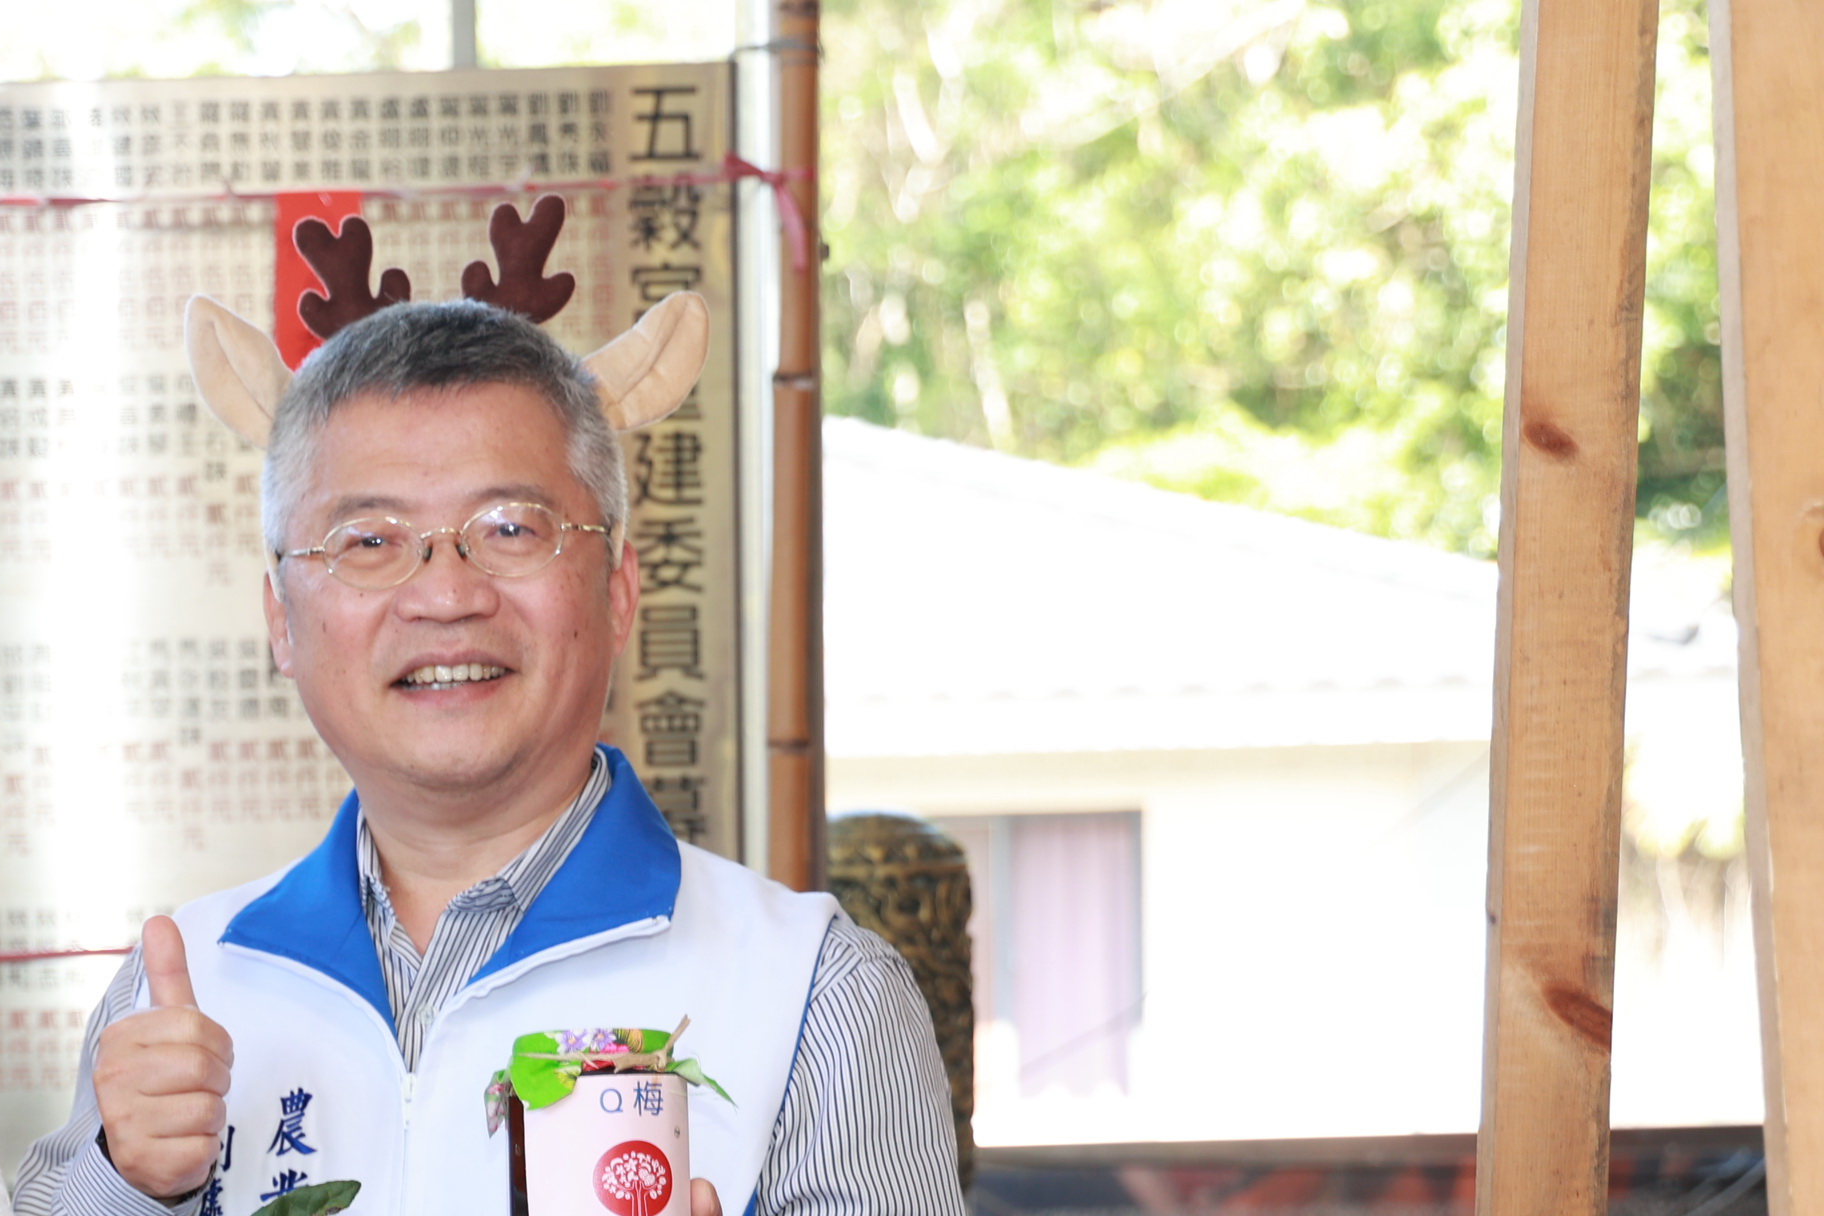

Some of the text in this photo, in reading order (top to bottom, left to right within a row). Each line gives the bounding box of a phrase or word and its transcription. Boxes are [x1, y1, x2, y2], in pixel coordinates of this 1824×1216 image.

[627, 85, 707, 845] 五穀宮建委員會
